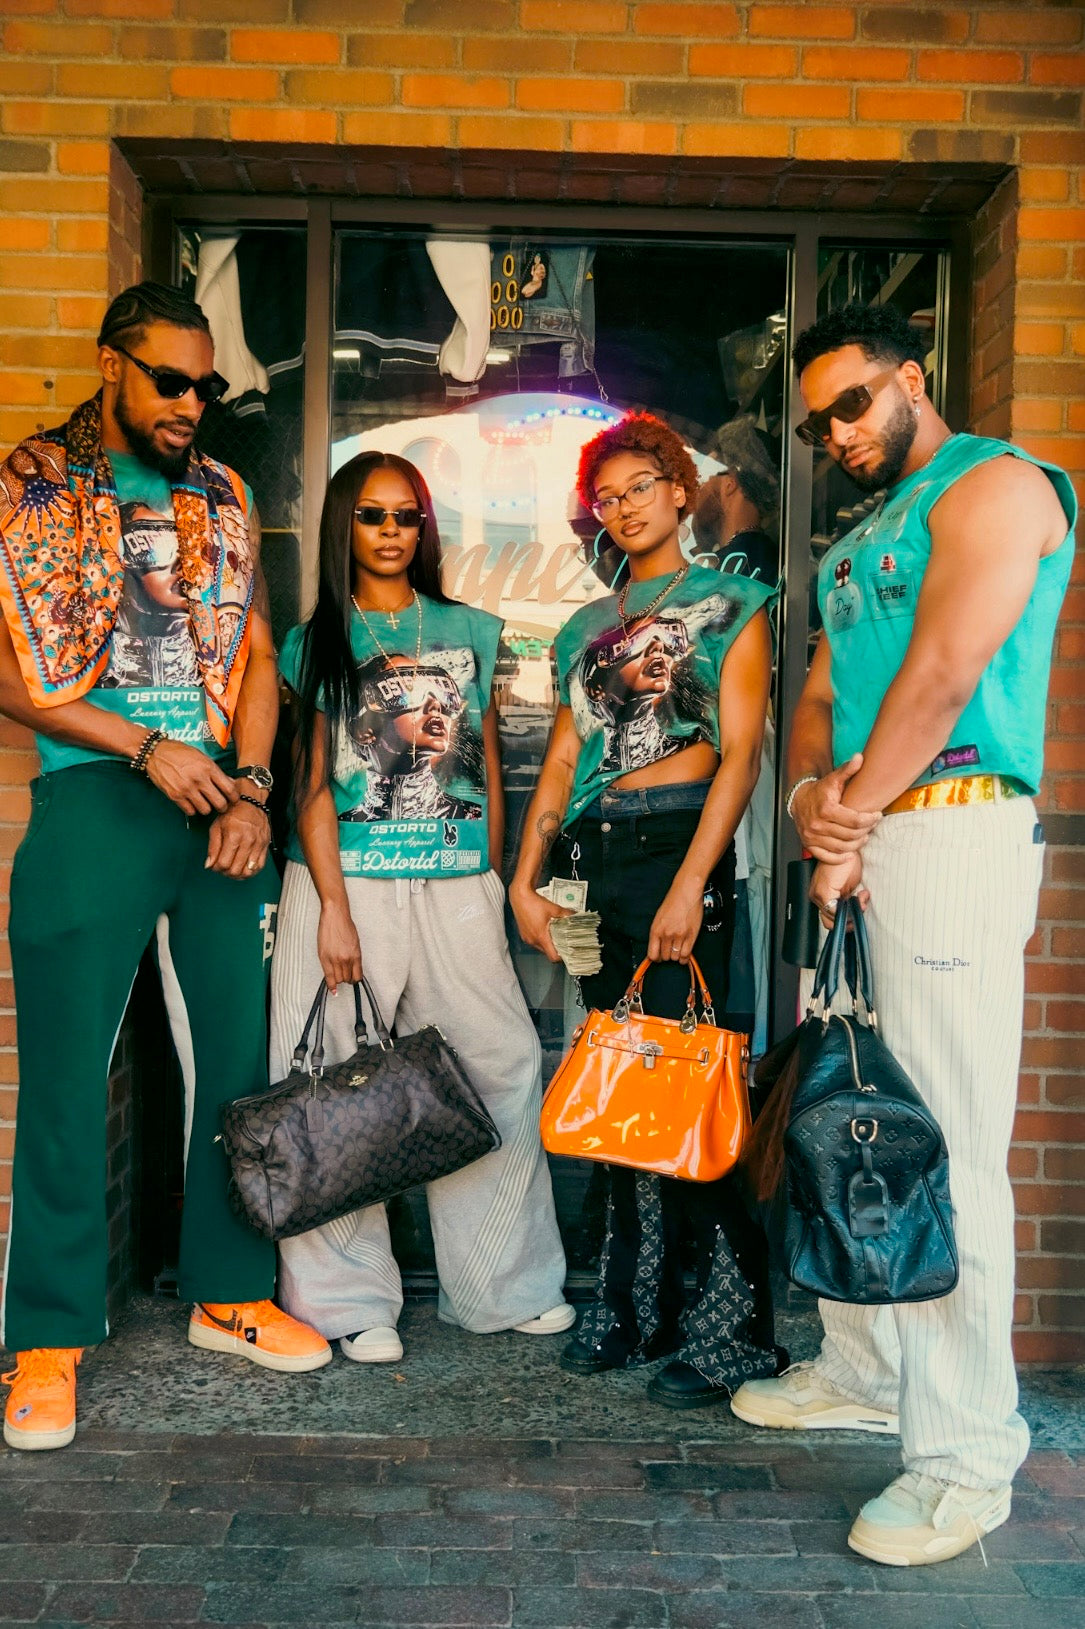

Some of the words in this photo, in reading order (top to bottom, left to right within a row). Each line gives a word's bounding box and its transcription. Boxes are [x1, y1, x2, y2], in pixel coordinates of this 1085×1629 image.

[127, 691, 200, 703] DSTORTD
[368, 823, 437, 834] DSTORTD
[362, 850, 440, 870] Dstortd
[914, 955, 950, 966] Christian
[952, 957, 970, 967] Dior
